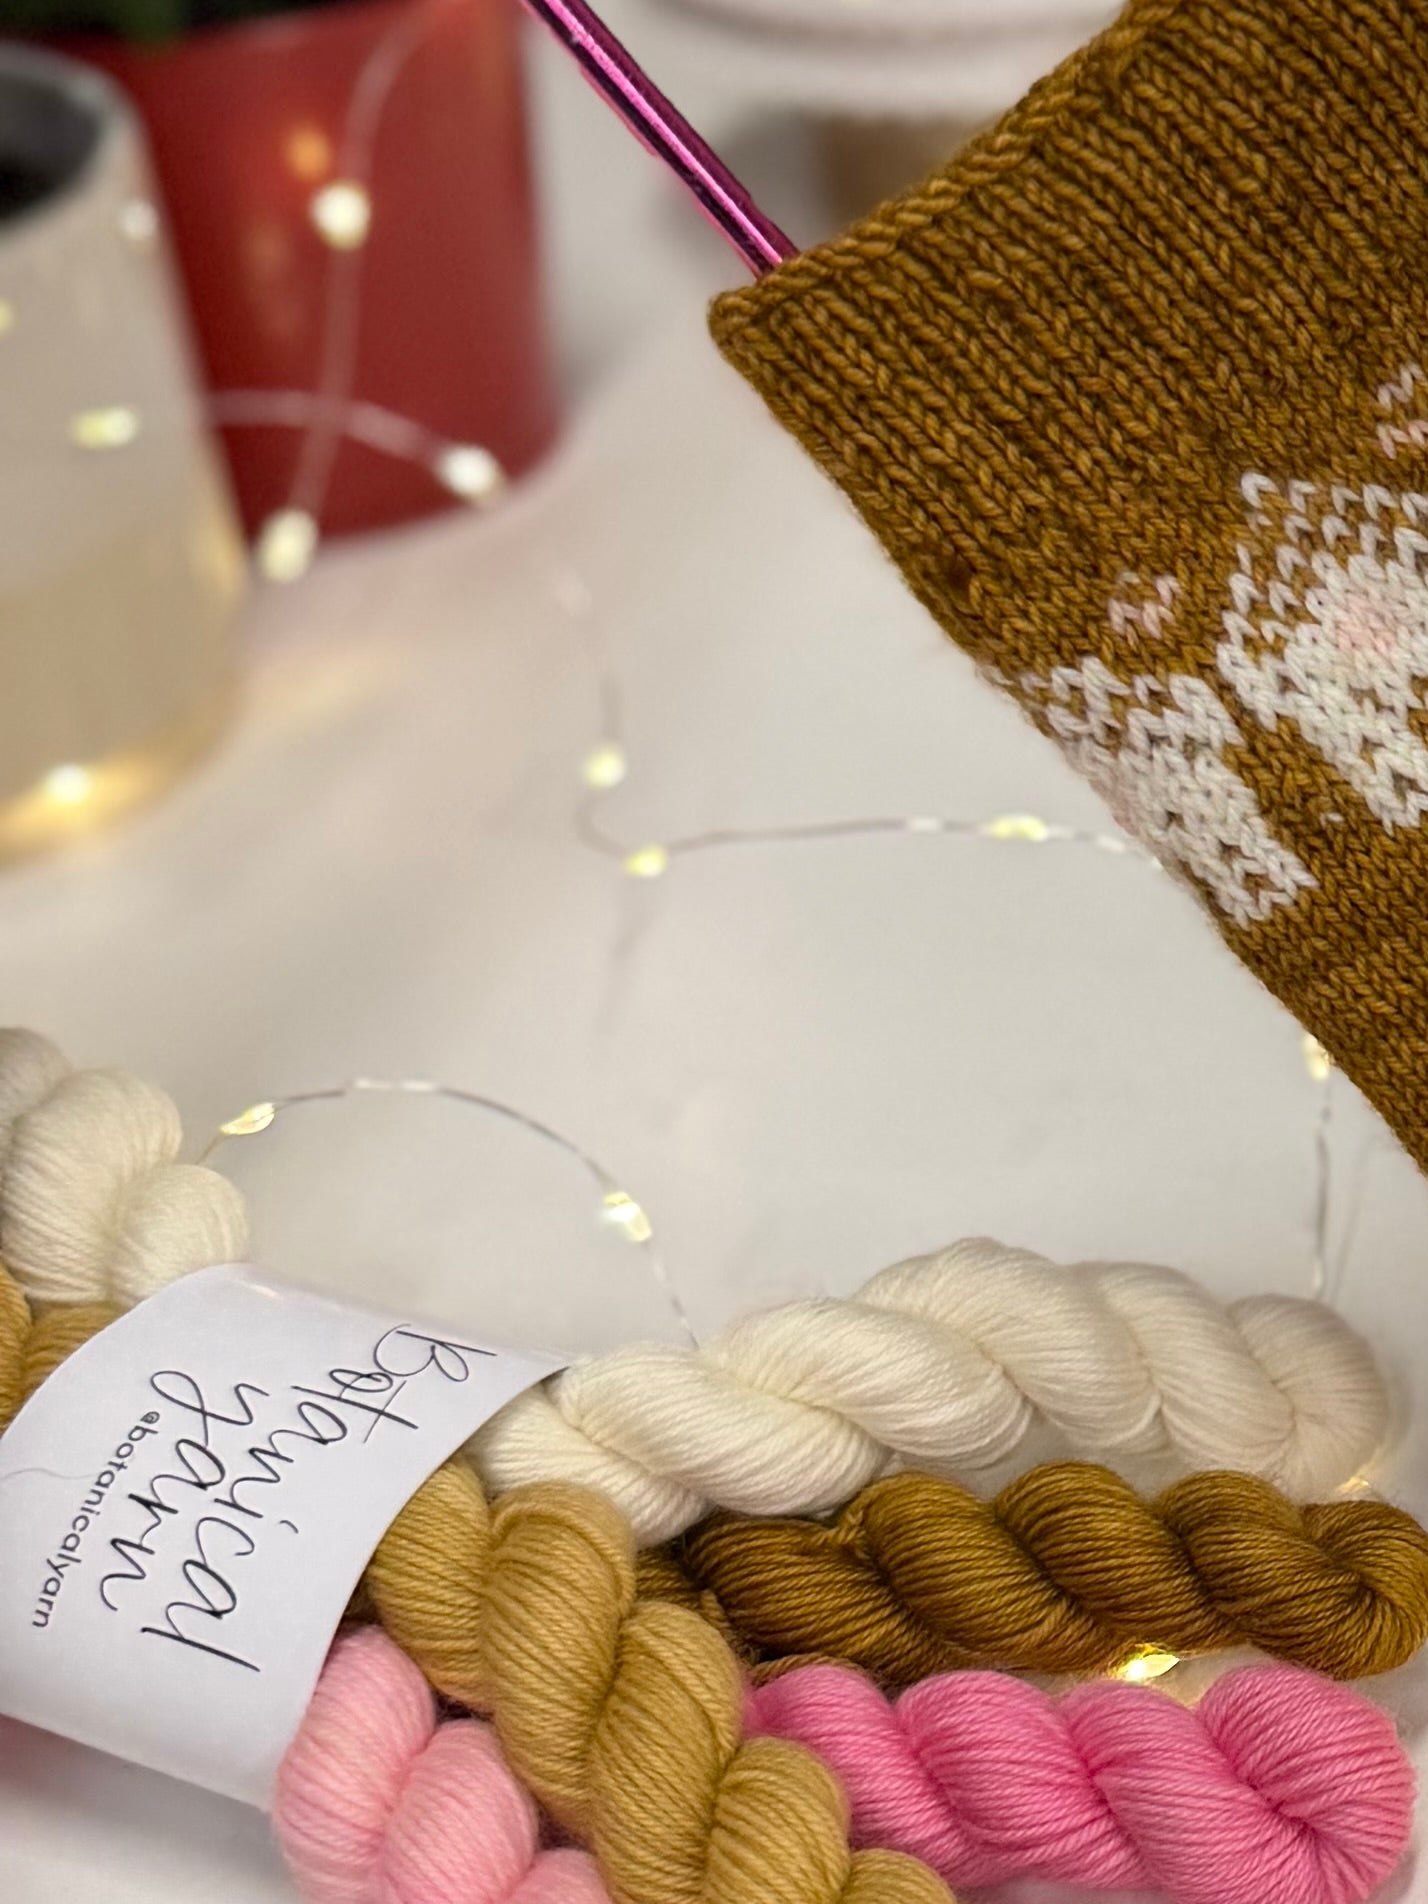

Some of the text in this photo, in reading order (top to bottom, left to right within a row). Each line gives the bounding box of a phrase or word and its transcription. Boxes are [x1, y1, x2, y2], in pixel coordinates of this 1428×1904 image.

[33, 1411, 160, 1628] @botanicalyarn
[100, 1371, 269, 1610] yarn
[141, 1323, 498, 1671] Botanical
